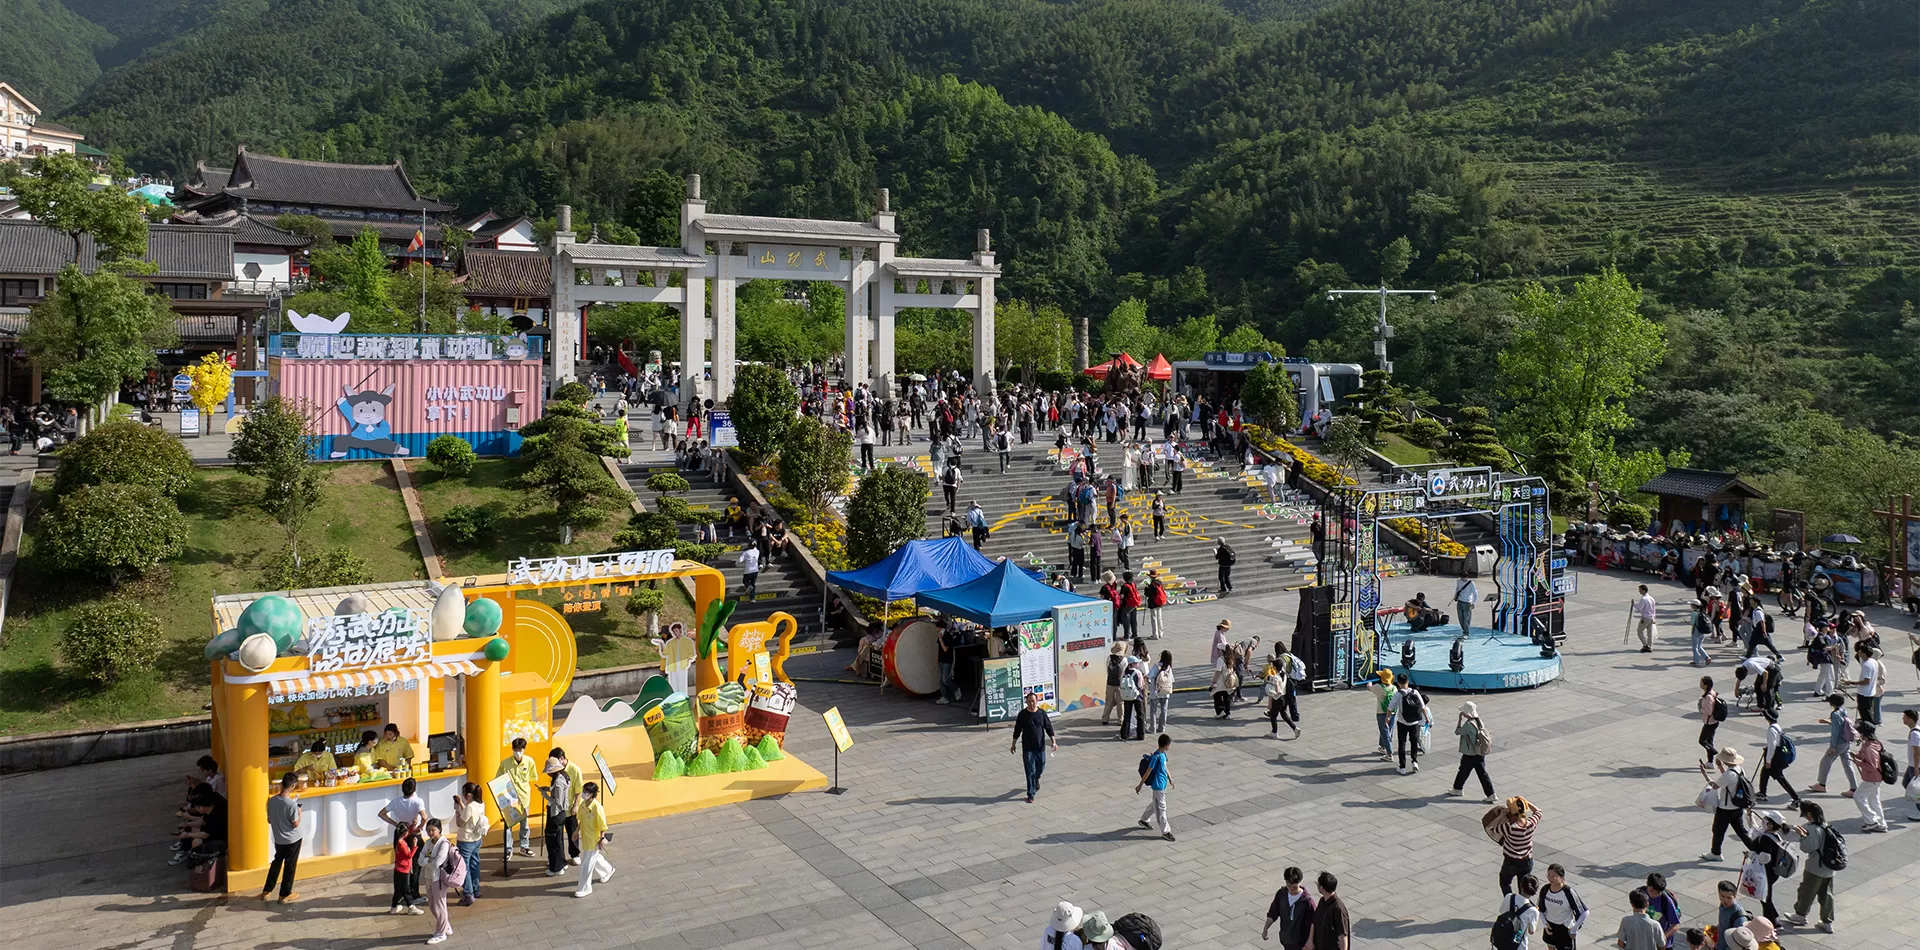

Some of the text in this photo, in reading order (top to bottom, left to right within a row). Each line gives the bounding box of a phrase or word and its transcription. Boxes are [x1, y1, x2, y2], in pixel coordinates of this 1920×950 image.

[298, 335, 493, 359] 欢迎来到武功山
[426, 385, 505, 401] 小小武功山
[1449, 474, 1487, 492] 武功山
[563, 600, 601, 614] 陪你登顶
